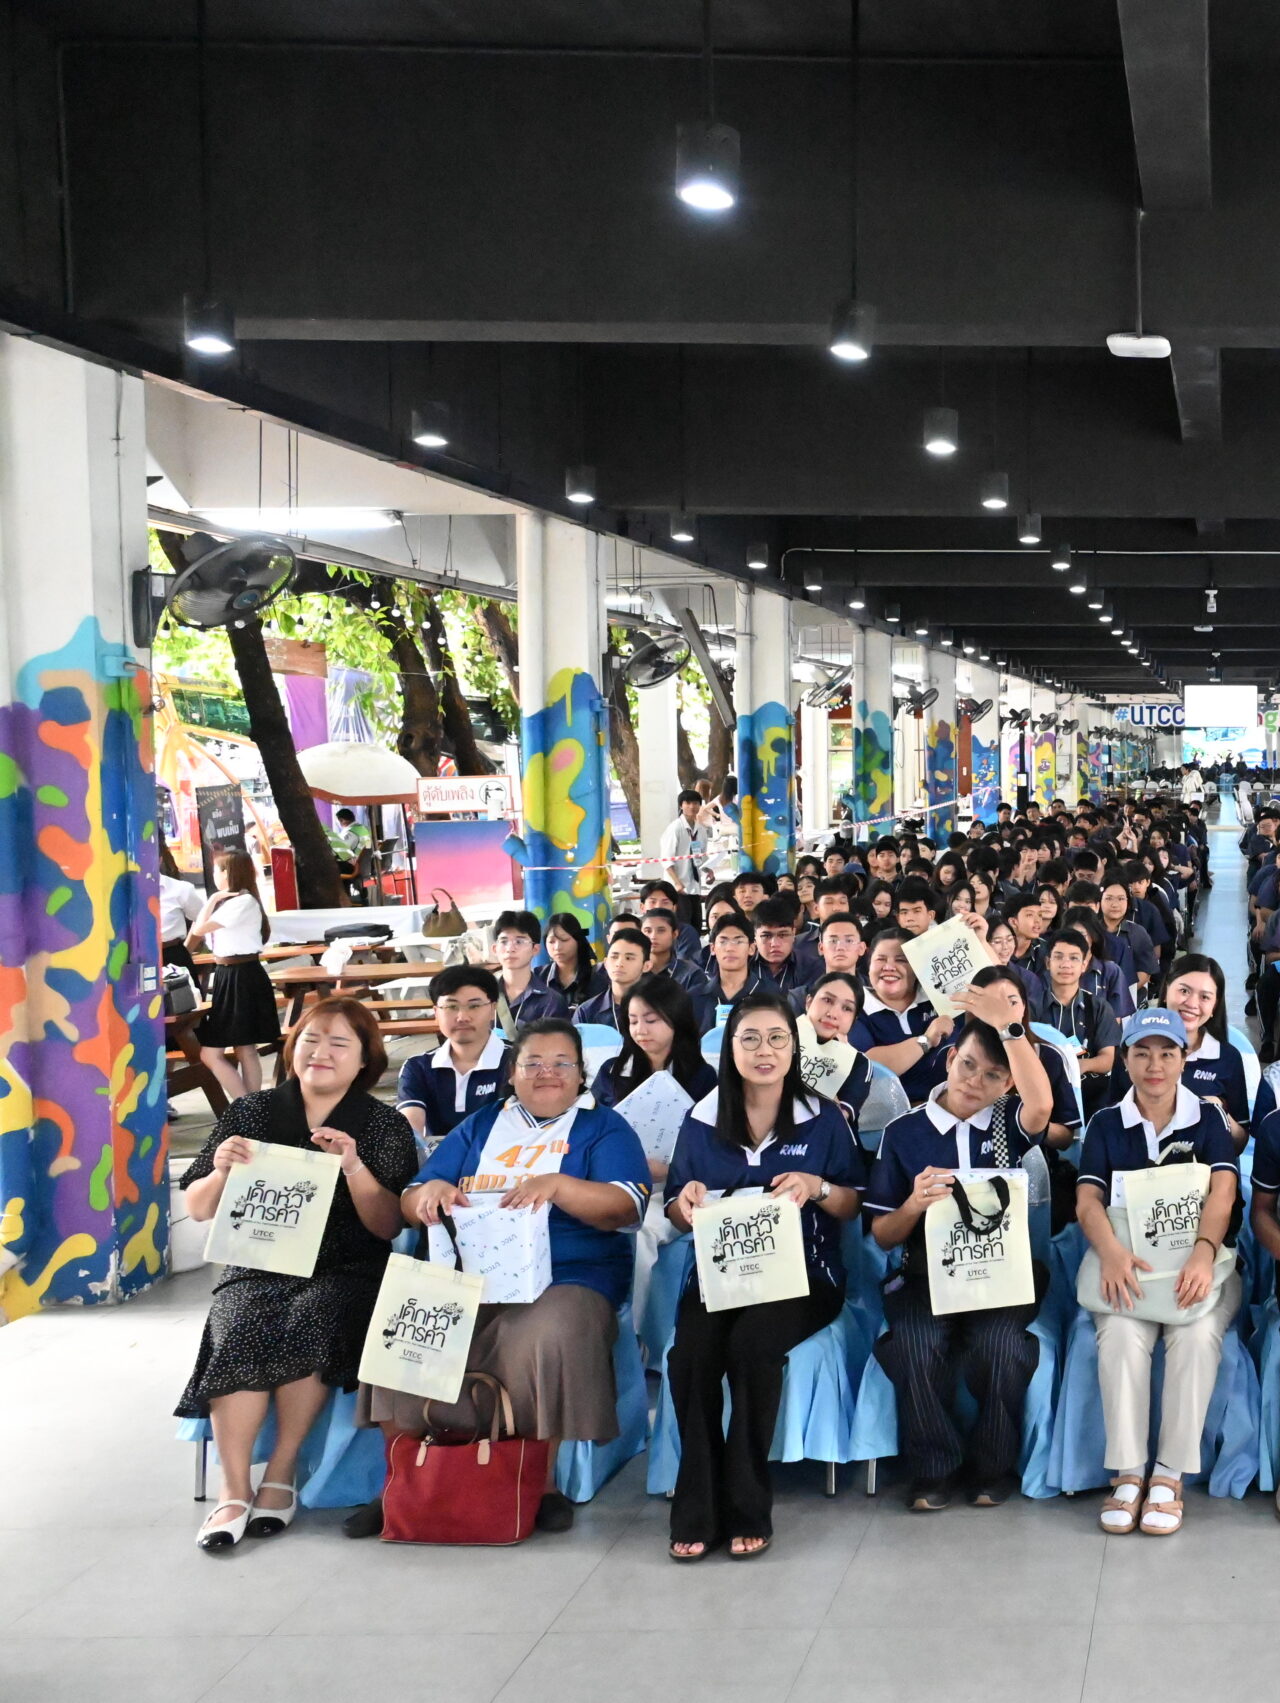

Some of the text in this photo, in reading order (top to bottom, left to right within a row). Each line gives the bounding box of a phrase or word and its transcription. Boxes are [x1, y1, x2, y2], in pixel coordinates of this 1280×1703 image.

[423, 785, 474, 807] ตู้ดับเพลิง
[1193, 1069, 1217, 1082] RNM
[780, 1144, 808, 1156] RNM
[981, 1140, 994, 1155] RN
[247, 1180, 303, 1208] เด็กหัว
[244, 1203, 299, 1224] การค้า
[1152, 1195, 1199, 1220] เด็กหัว
[253, 1228, 275, 1238] UTCC
[719, 1213, 773, 1242] เด็กหัว
[722, 1231, 776, 1257] การค้า
[952, 1239, 1004, 1261] การค้า
[1170, 1239, 1190, 1248] UTCC
[740, 1263, 760, 1272] UTCC
[968, 1269, 987, 1277] UTCC
[398, 1298, 451, 1330] เด็กหัว
[394, 1321, 446, 1348] การค้า
[403, 1348, 422, 1360] UTCC
